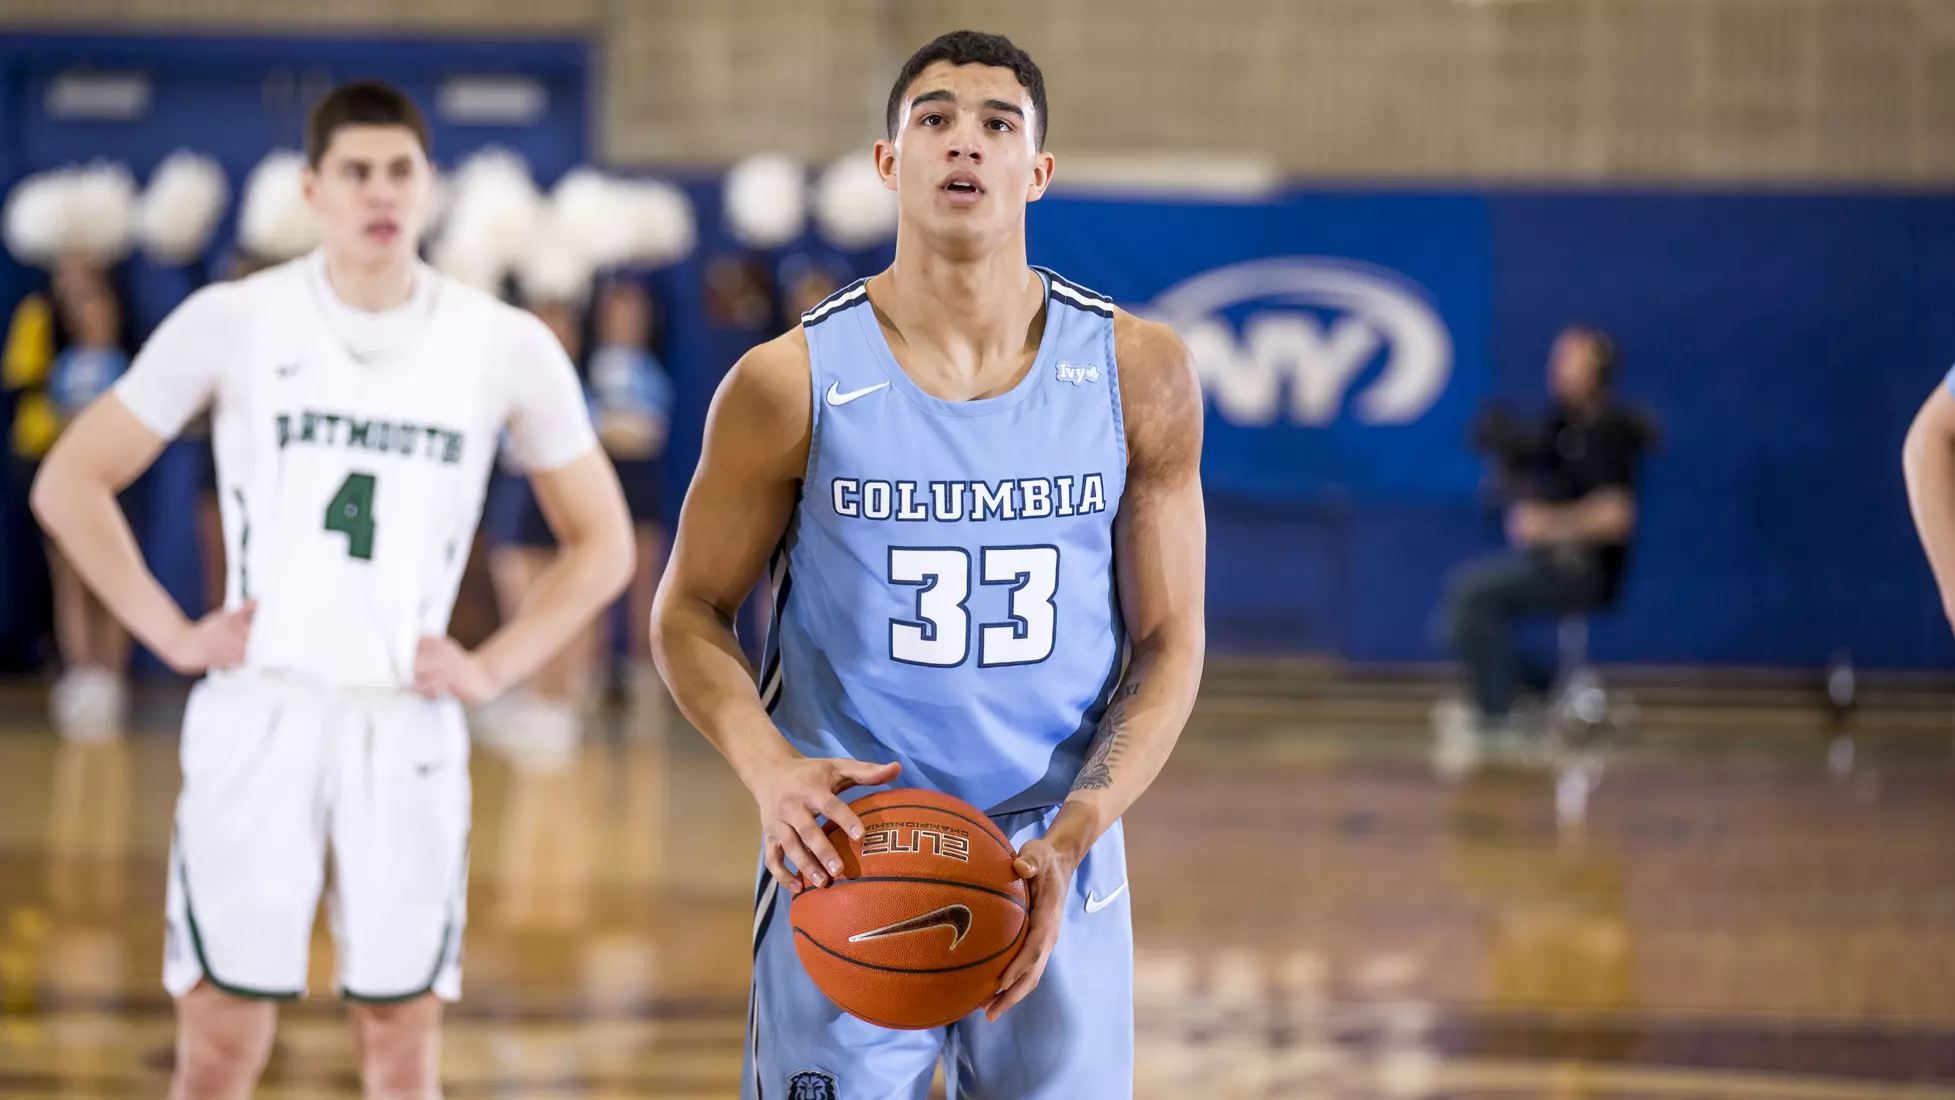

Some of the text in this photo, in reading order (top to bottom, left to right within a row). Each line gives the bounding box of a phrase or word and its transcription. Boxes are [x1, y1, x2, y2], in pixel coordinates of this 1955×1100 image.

[1059, 362, 1086, 384] Ivy
[276, 411, 461, 463] DRTMOUTH
[324, 472, 376, 560] 4
[831, 473, 1106, 522] COLUMBIA
[887, 543, 1061, 668] 33
[861, 829, 969, 863] ELITE
